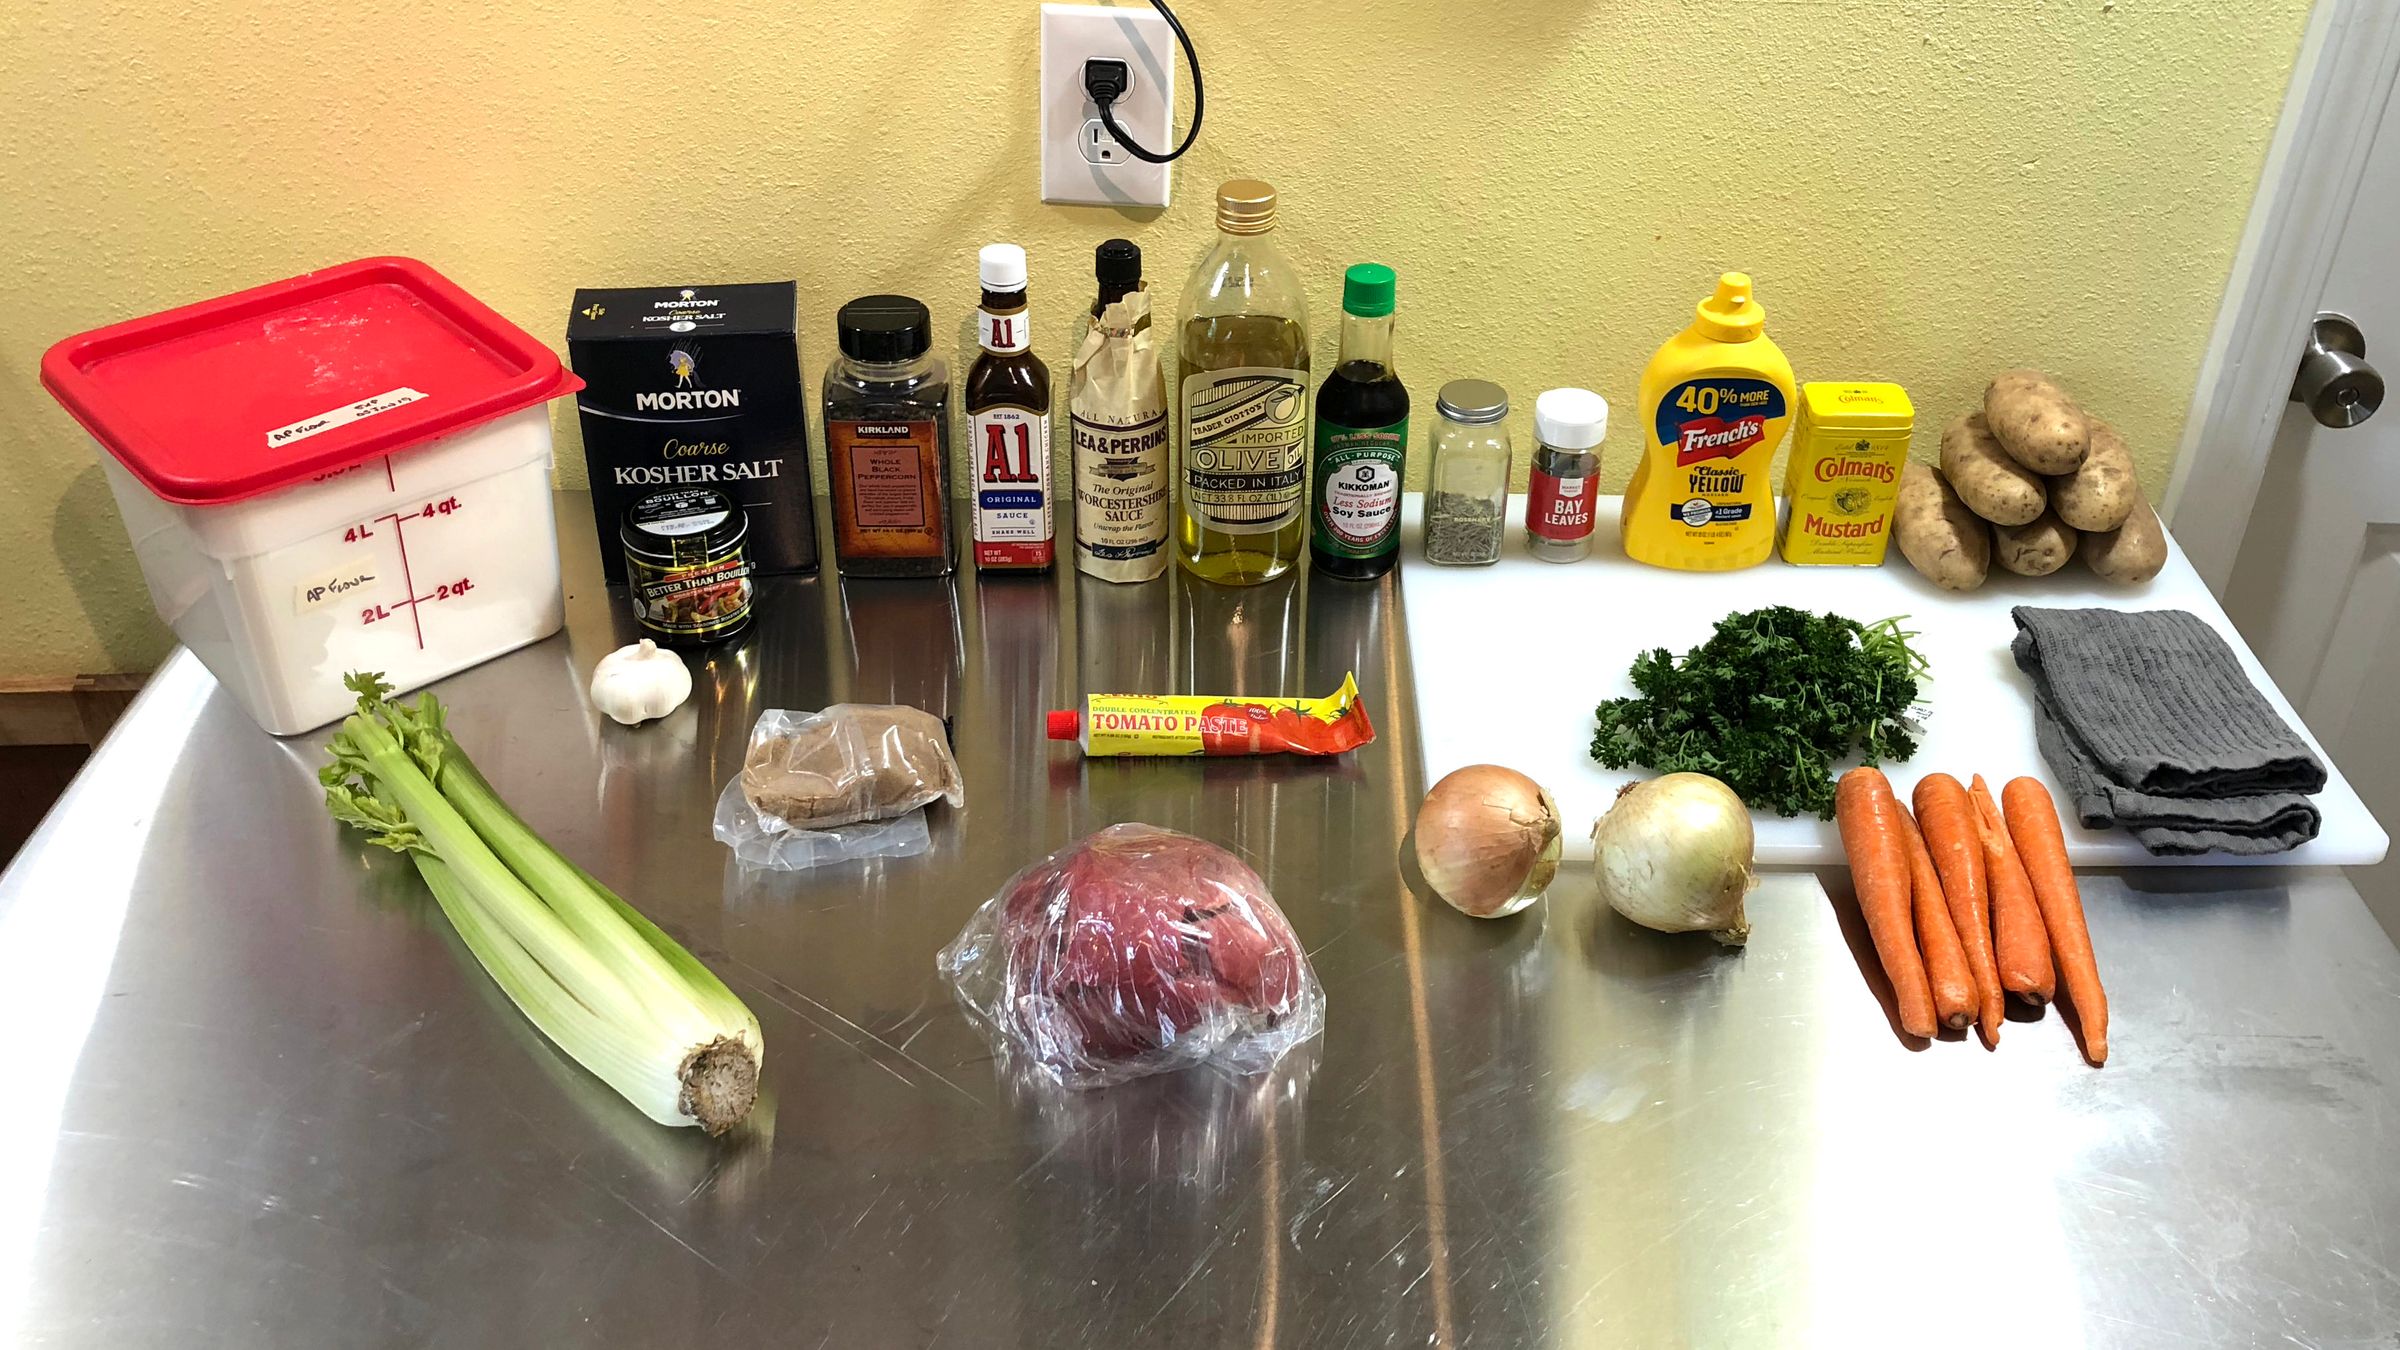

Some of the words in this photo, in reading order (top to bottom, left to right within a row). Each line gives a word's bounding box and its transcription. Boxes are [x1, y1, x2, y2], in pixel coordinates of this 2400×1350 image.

[654, 300, 719, 309] MORTON
[642, 314, 694, 322] KOSHER
[635, 389, 740, 411] MORTON
[1676, 386, 1738, 415] 40%
[1740, 390, 1770, 403] MORE
[1081, 410, 1099, 421] ALL
[858, 426, 909, 434] KIRKLAND
[1193, 420, 1224, 436] TRADER
[1241, 426, 1304, 444] IMPORTED
[1683, 421, 1759, 453] French's
[663, 438, 730, 460] Coarse
[1195, 449, 1281, 471] OLIVE
[1287, 449, 1302, 465] OIL
[614, 464, 719, 485] KOSHER
[722, 459, 783, 482] SALT
[1694, 466, 1740, 476] Classic
[1815, 457, 1895, 484] Colman's
[1194, 475, 1246, 489] PACKED
[1252, 476, 1266, 489] IN
[1271, 471, 1301, 487] ITALY
[1338, 480, 1390, 491] KIKKOMAN
[1689, 474, 1744, 494] YELLOW
[1093, 484, 1110, 495] The
[1112, 481, 1154, 497] Original
[1194, 491, 1212, 501] NET
[1237, 494, 1247, 502] FL
[1248, 493, 1263, 502] OZ
[1334, 496, 1354, 508] Less
[1357, 497, 1392, 508] Sodium
[1554, 499, 1583, 514] BAY
[1105, 509, 1144, 521] SAUCE
[1332, 506, 1353, 518] Soy
[1357, 506, 1391, 518] Sauce
[1544, 512, 1589, 526] LEAVES
[1723, 507, 1742, 515] Grade
[1803, 513, 1885, 538] Mustard
[681, 565, 725, 578] PREMIUM
[646, 583, 681, 597] BETTER
[683, 576, 714, 588] THAN
[307, 587, 325, 603] AP
[1092, 713, 1178, 731] TOMATO
[1185, 716, 1249, 734] PASTE
